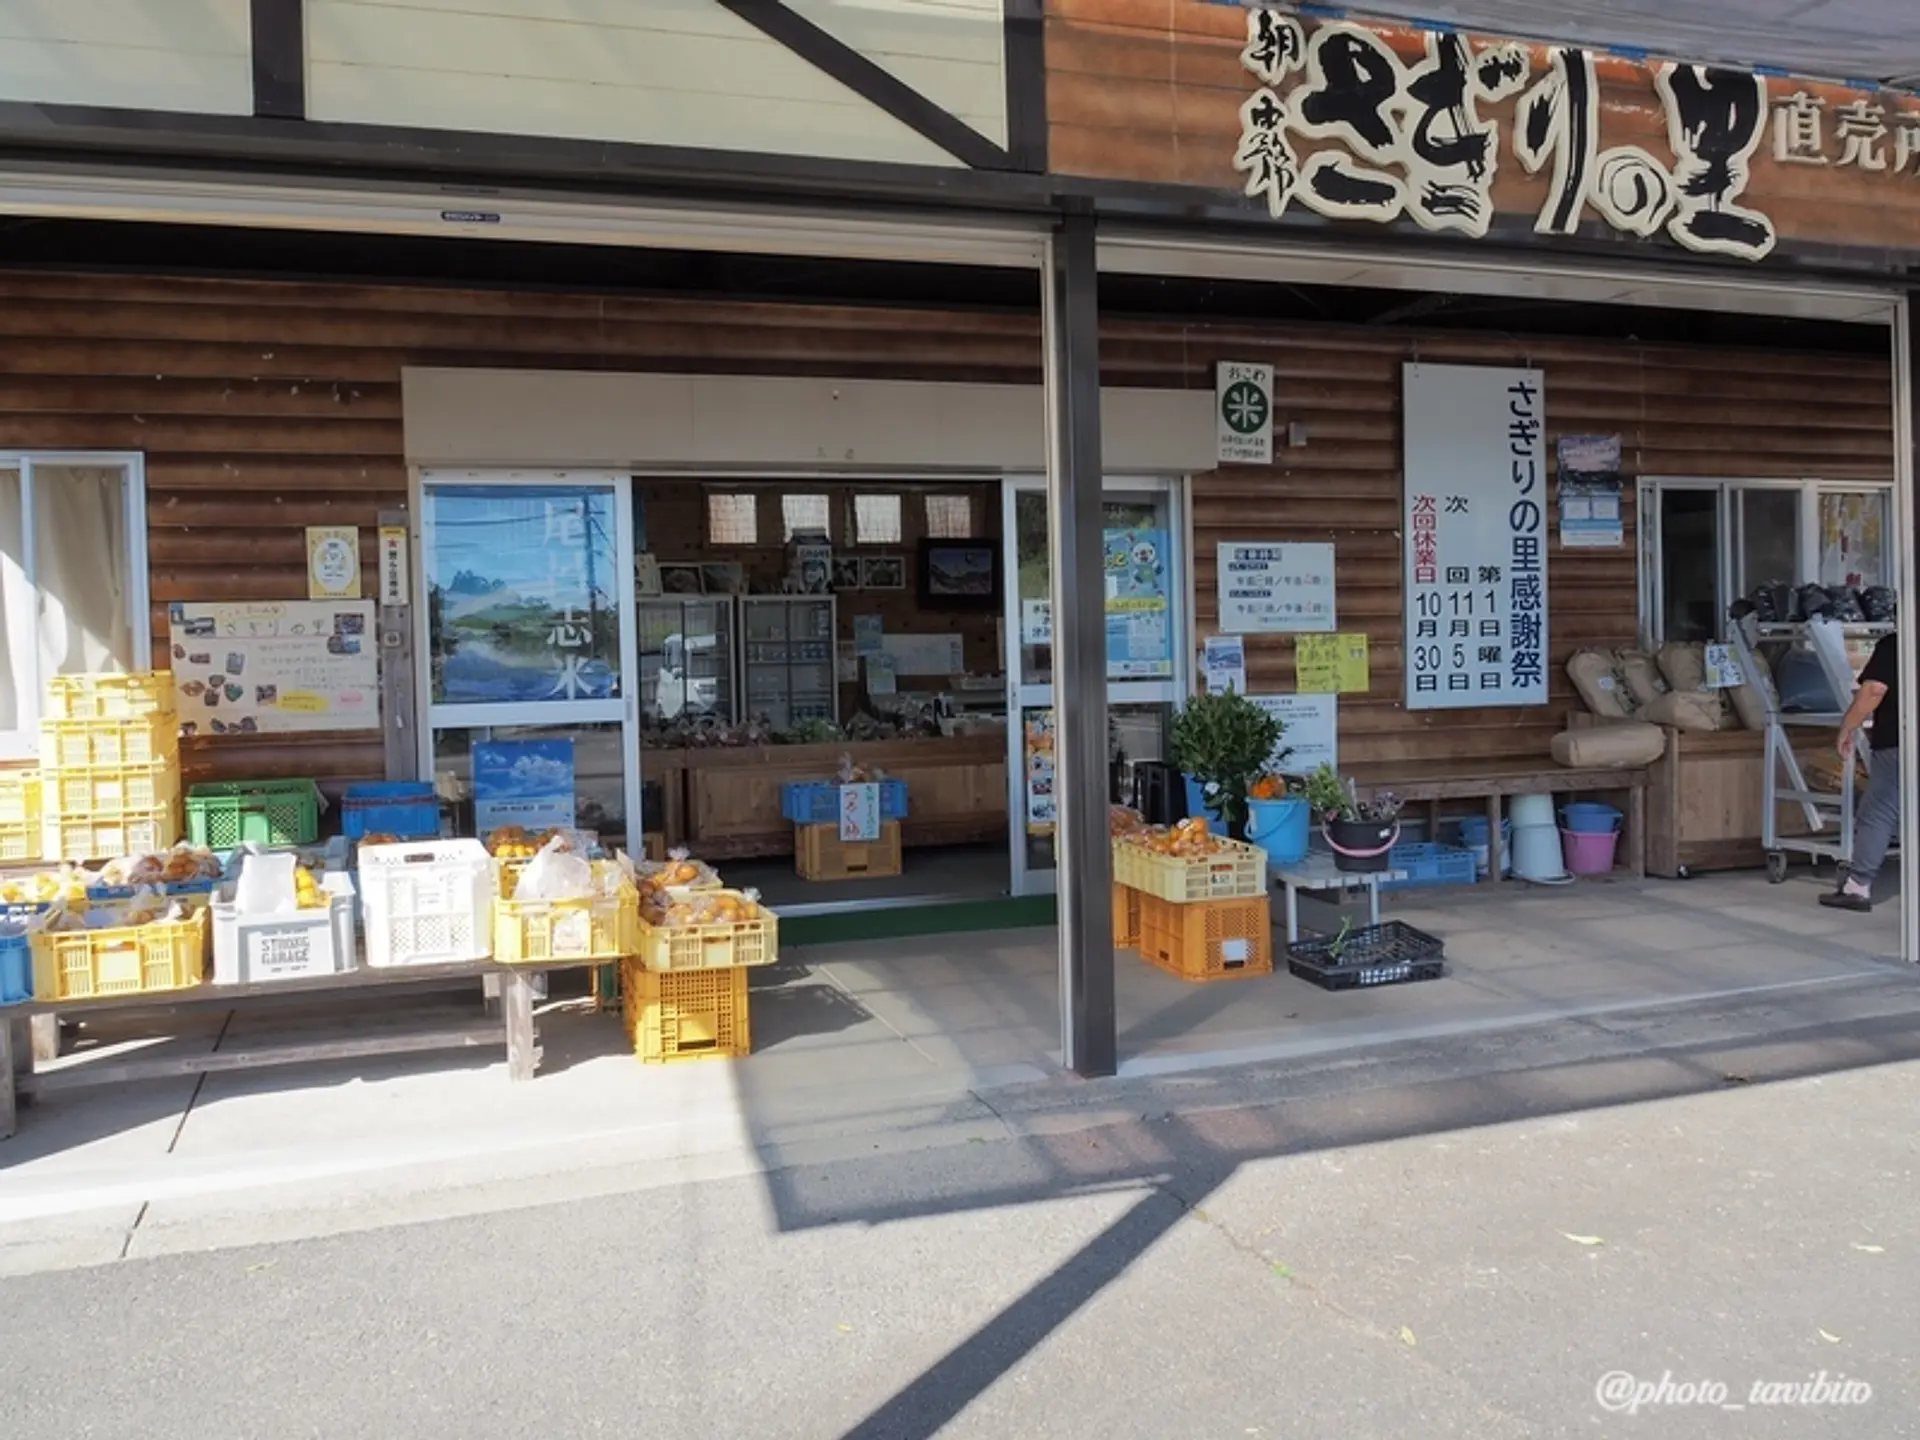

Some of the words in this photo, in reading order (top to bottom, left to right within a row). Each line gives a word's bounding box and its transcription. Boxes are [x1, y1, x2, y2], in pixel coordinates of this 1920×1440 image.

[1301, 29, 1772, 250] さぎりの里
[1507, 380, 1543, 689] さぎりの里感謝祭
